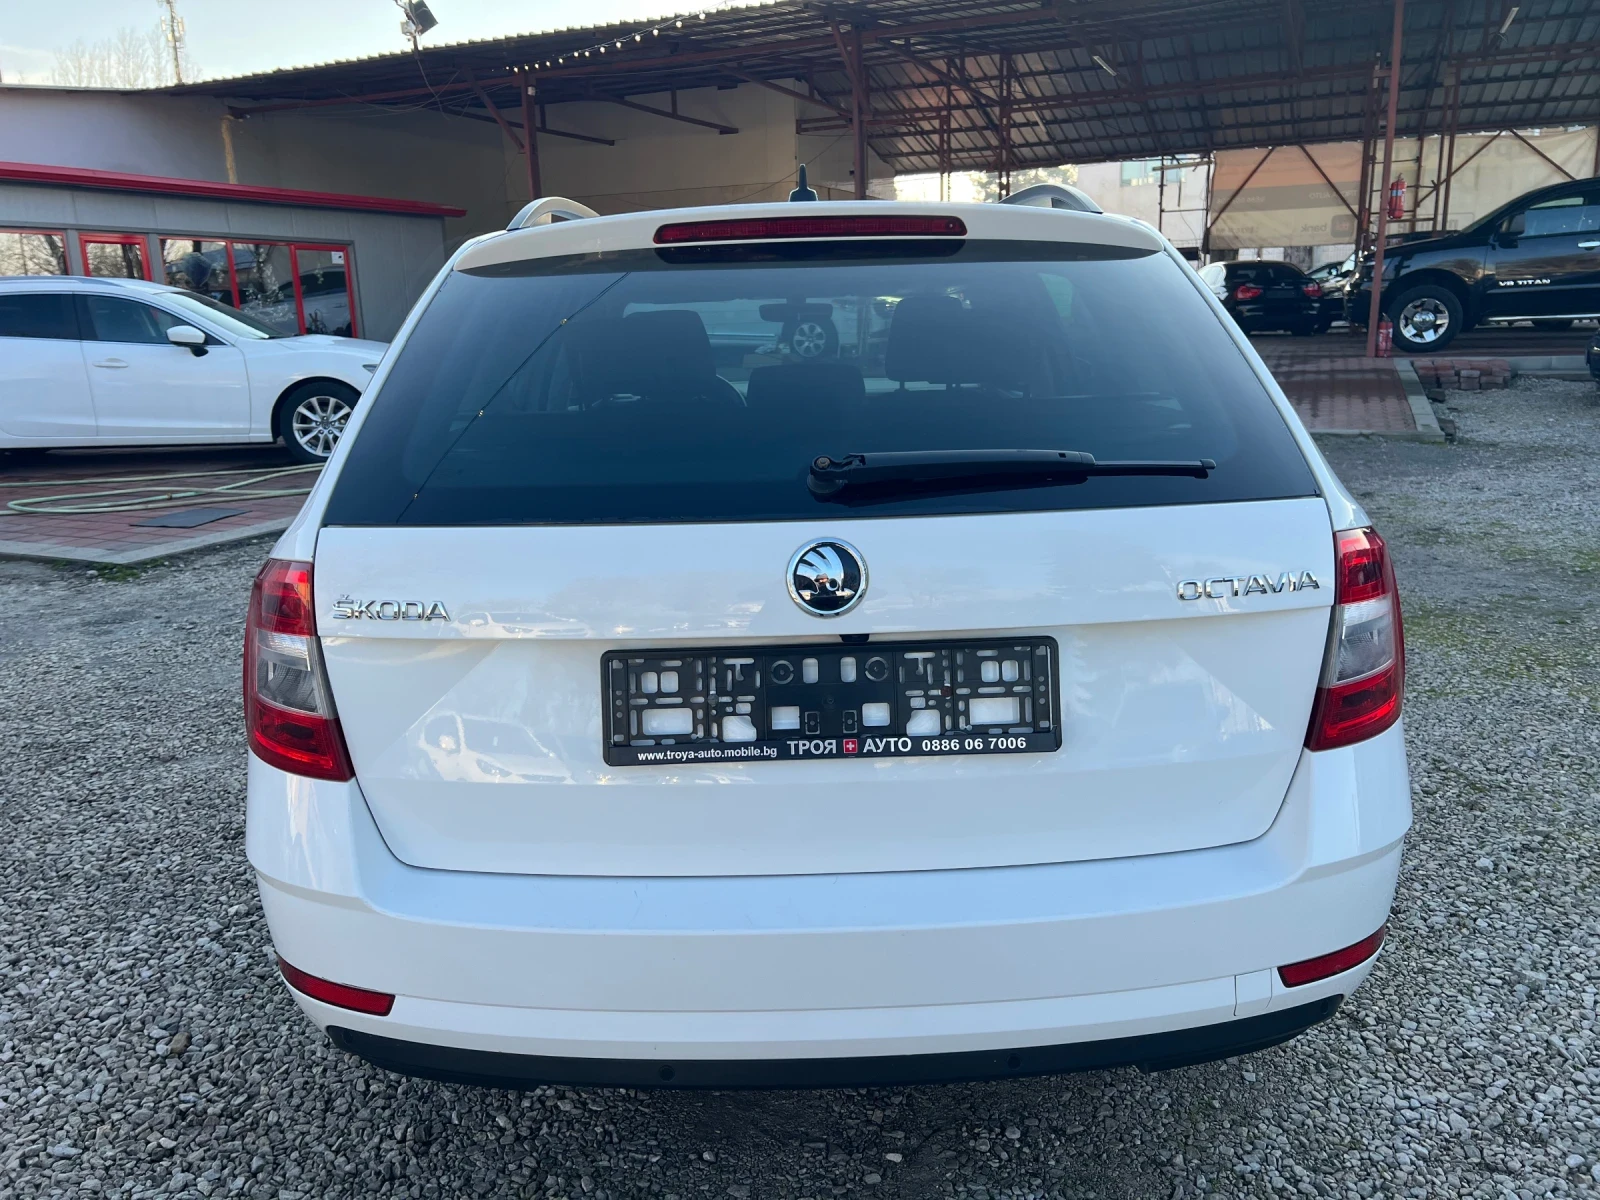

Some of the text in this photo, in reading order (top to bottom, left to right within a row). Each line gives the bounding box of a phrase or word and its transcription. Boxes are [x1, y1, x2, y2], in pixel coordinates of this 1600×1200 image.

[1516, 278, 1551, 286] TITAN
[1177, 569, 1321, 601] OCTAVIA
[332, 594, 452, 622] ŠKODA
[637, 737, 1027, 762] www.troya-auto.mobile.bg ТРОЯ АУТО 0886 06 7006
